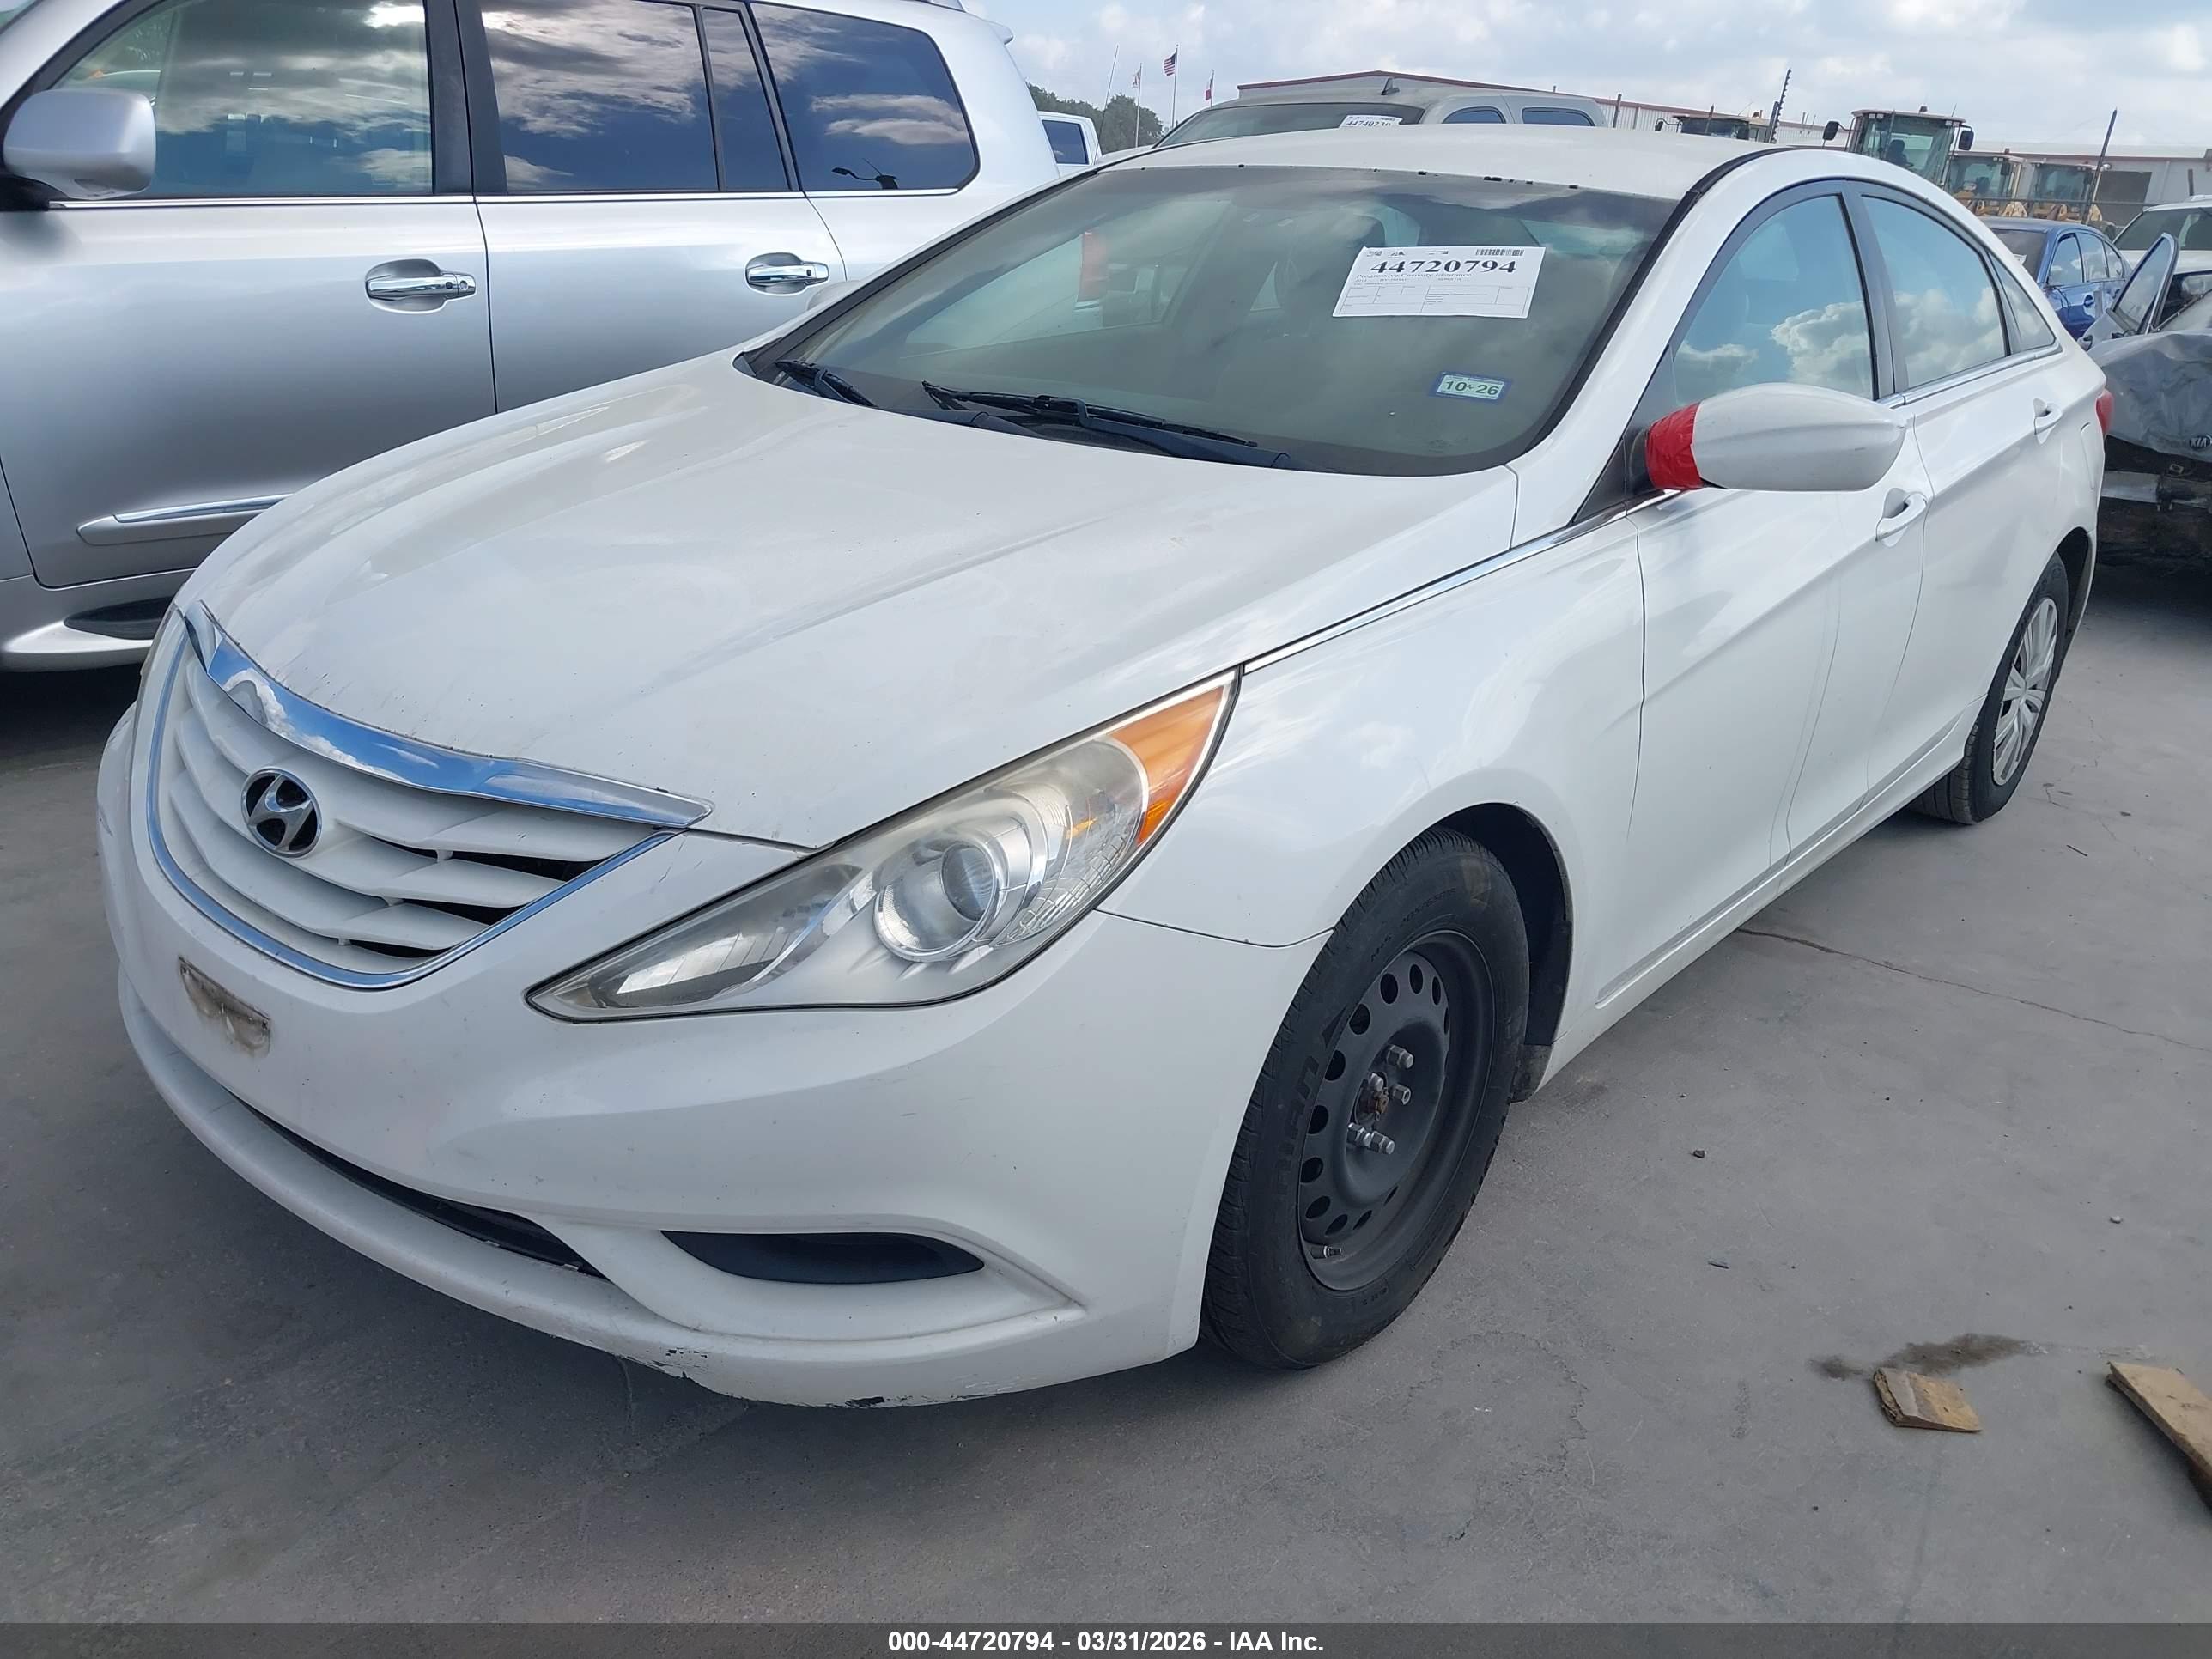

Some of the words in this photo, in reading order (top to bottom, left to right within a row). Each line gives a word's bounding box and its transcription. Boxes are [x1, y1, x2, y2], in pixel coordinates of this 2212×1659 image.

[1370, 260, 1516, 274] 44720794
[1446, 380, 1468, 392] 10
[1474, 384, 1500, 395] 26
[2191, 437, 2207, 447] KIA
